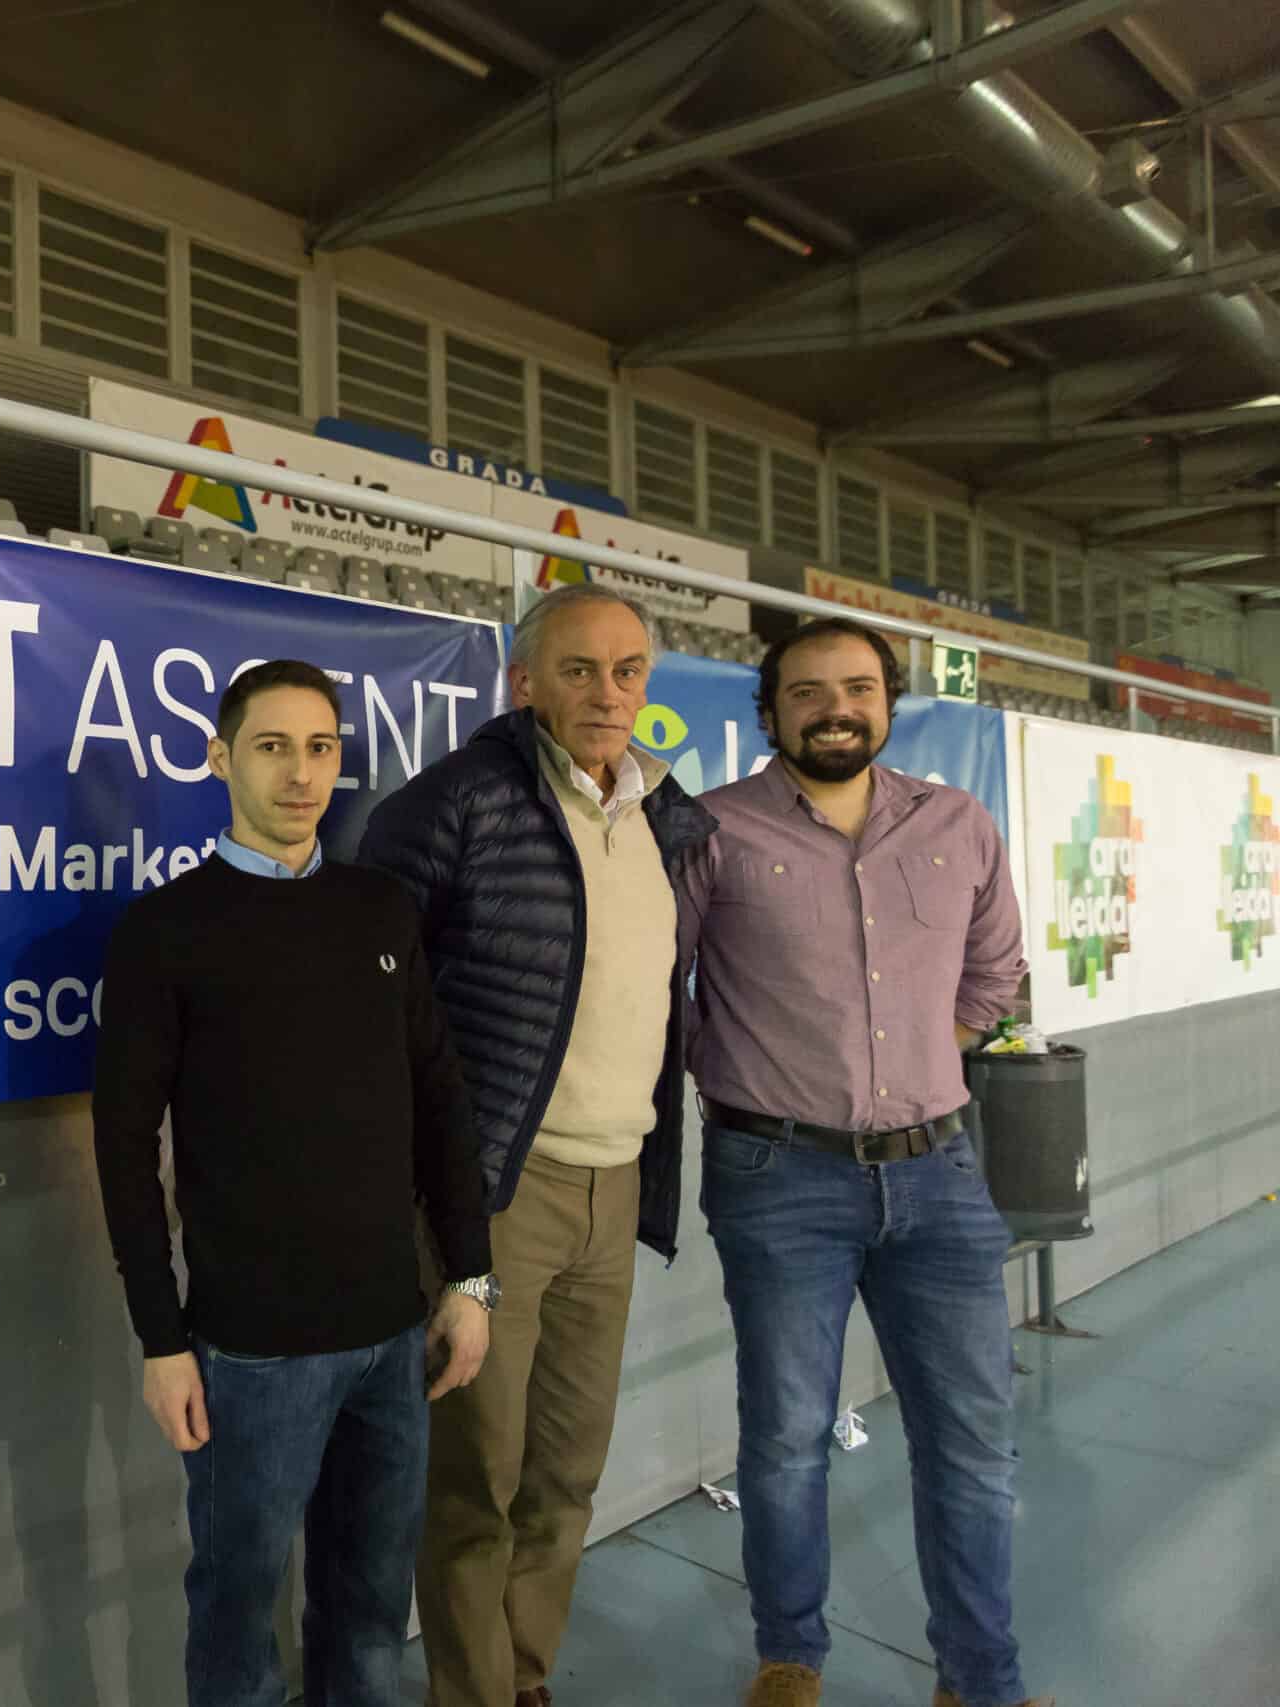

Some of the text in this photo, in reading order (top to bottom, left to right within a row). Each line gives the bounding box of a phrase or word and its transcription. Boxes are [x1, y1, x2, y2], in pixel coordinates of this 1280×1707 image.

[429, 448, 548, 497] GRADA
[290, 518, 424, 557] www.actelgrup.com
[67, 639, 478, 791] ASNT
